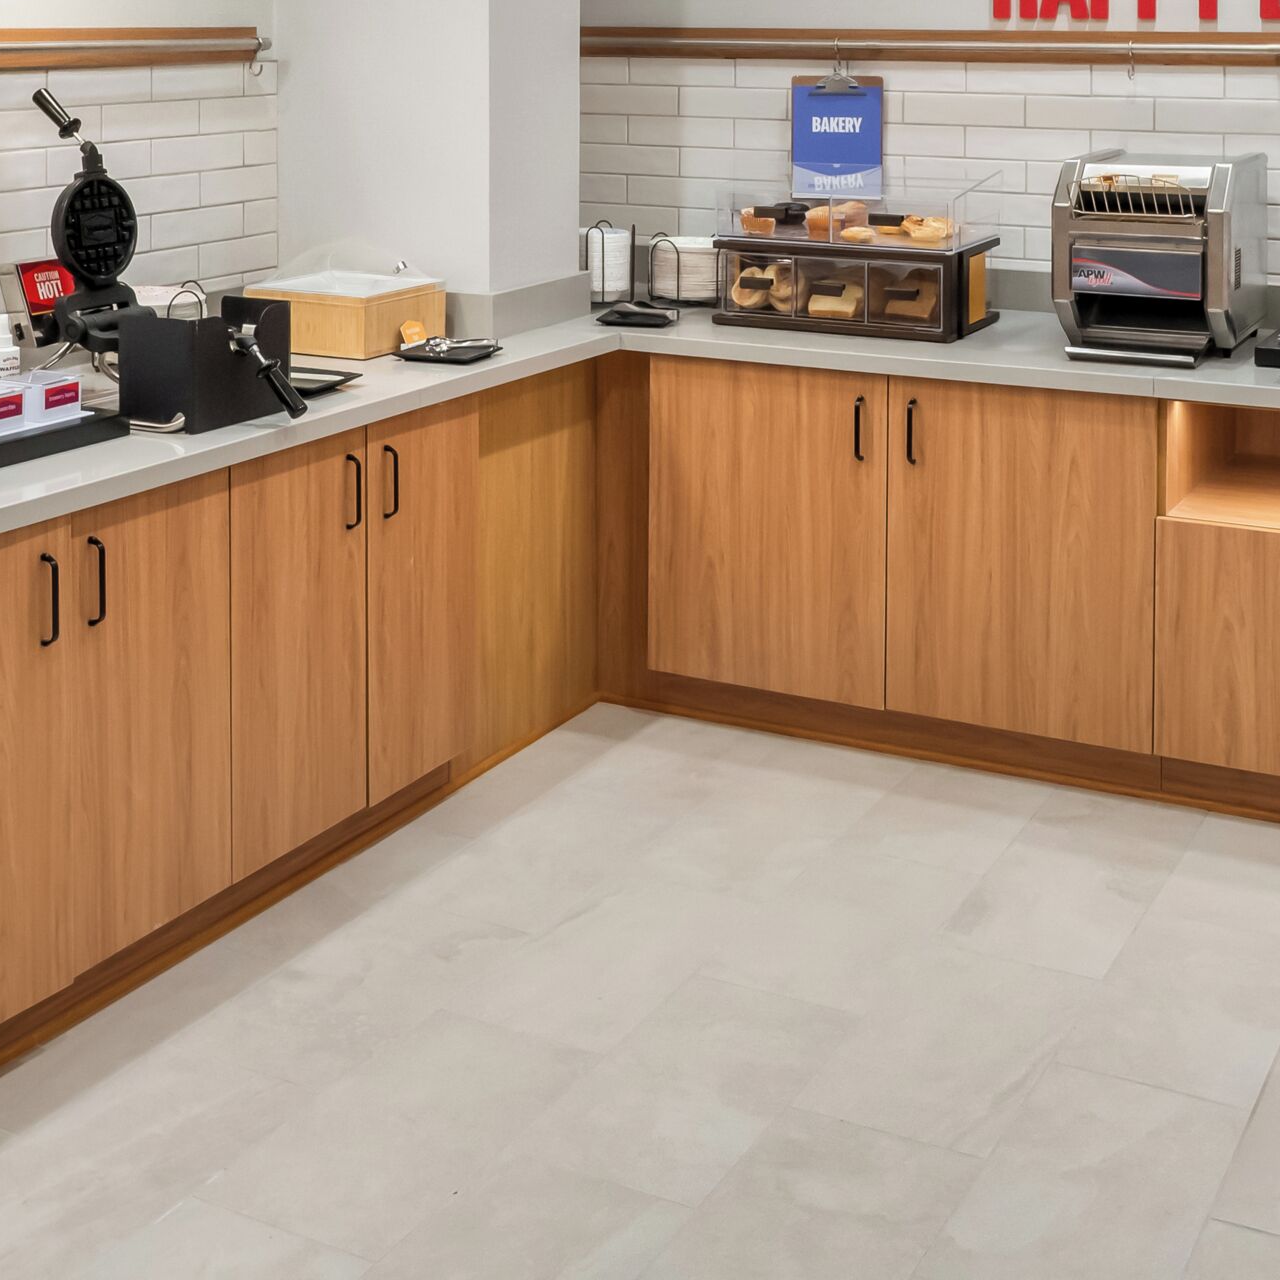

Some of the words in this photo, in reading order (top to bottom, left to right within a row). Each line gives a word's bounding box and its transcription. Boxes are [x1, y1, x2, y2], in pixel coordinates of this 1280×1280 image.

[811, 116, 862, 133] BAKERY
[33, 270, 60, 282] CAUTION
[1078, 269, 1105, 279] APW
[36, 280, 64, 300] HOT!
